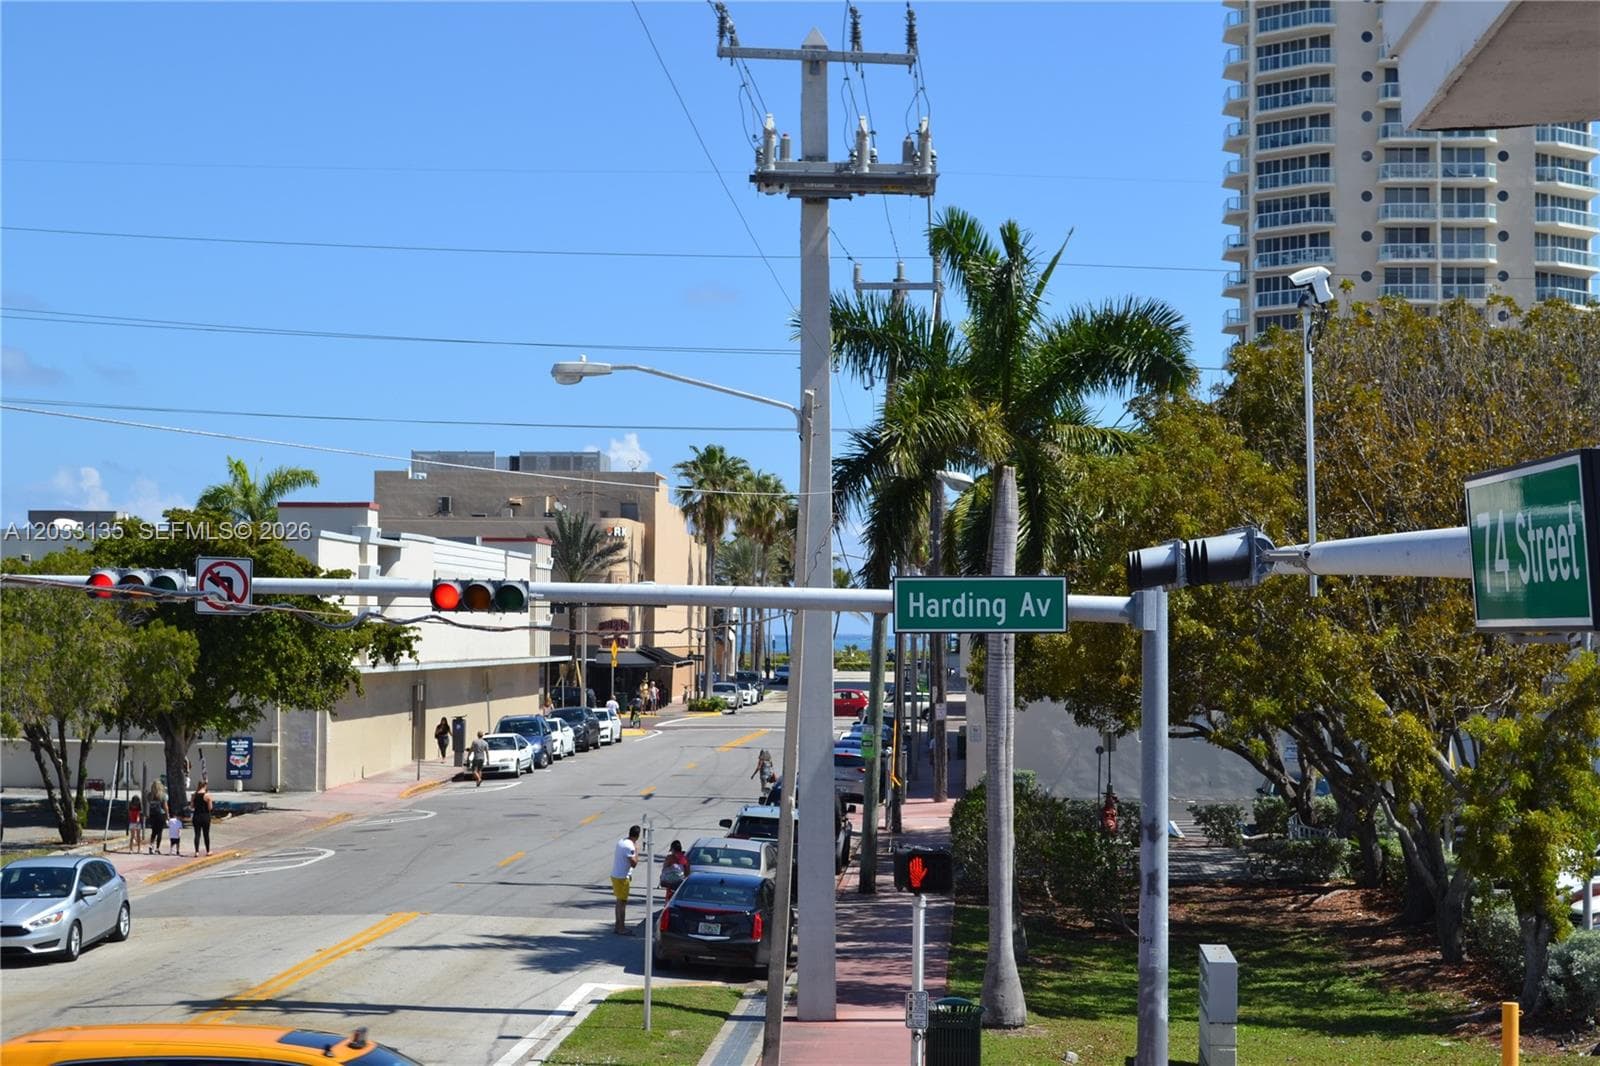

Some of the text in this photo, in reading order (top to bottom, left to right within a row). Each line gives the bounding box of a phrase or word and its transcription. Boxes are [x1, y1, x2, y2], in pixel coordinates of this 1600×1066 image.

[1477, 501, 1580, 594] 74 Street
[909, 592, 1051, 625] Harding Av
